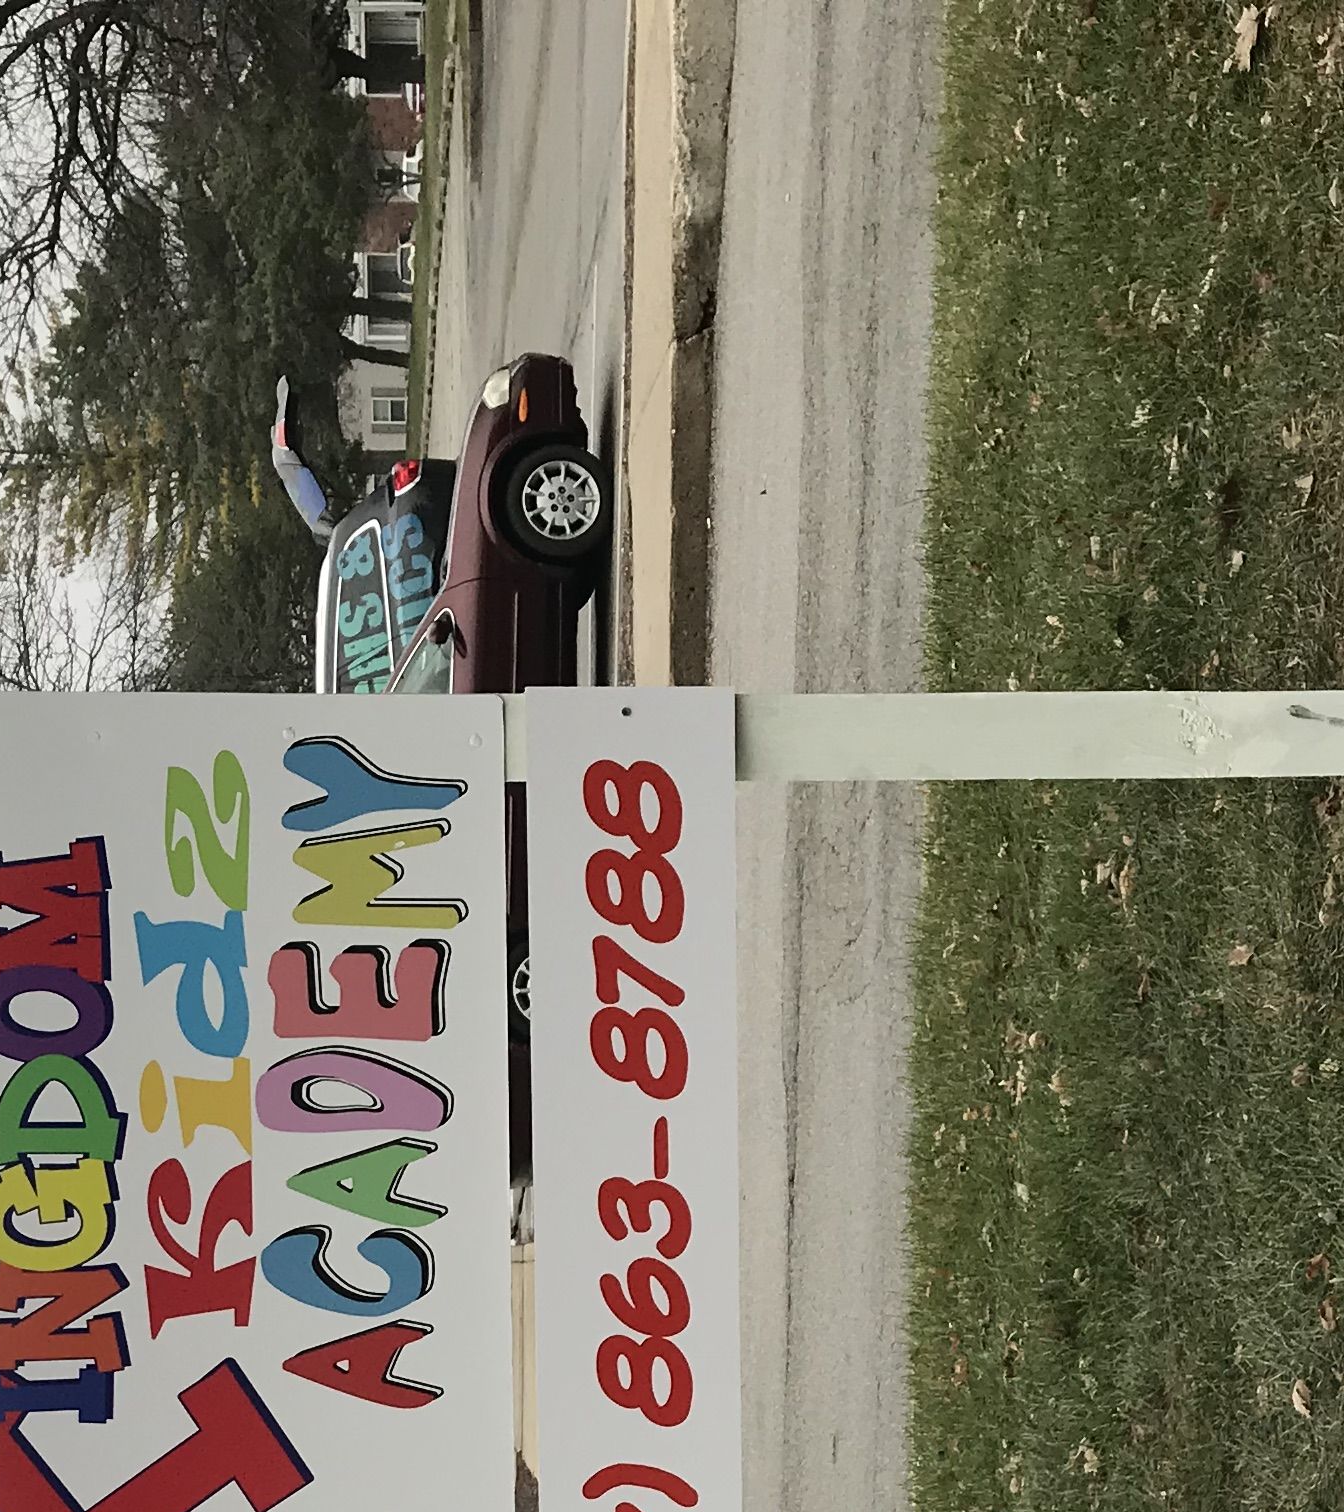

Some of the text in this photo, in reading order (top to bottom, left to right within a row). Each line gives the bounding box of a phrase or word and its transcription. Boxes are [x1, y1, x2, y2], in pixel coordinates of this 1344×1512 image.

[133, 749, 254, 1340] Kidz
[255, 735, 468, 1409] ACADEMY
[583, 759, 693, 1428] 863-8788
